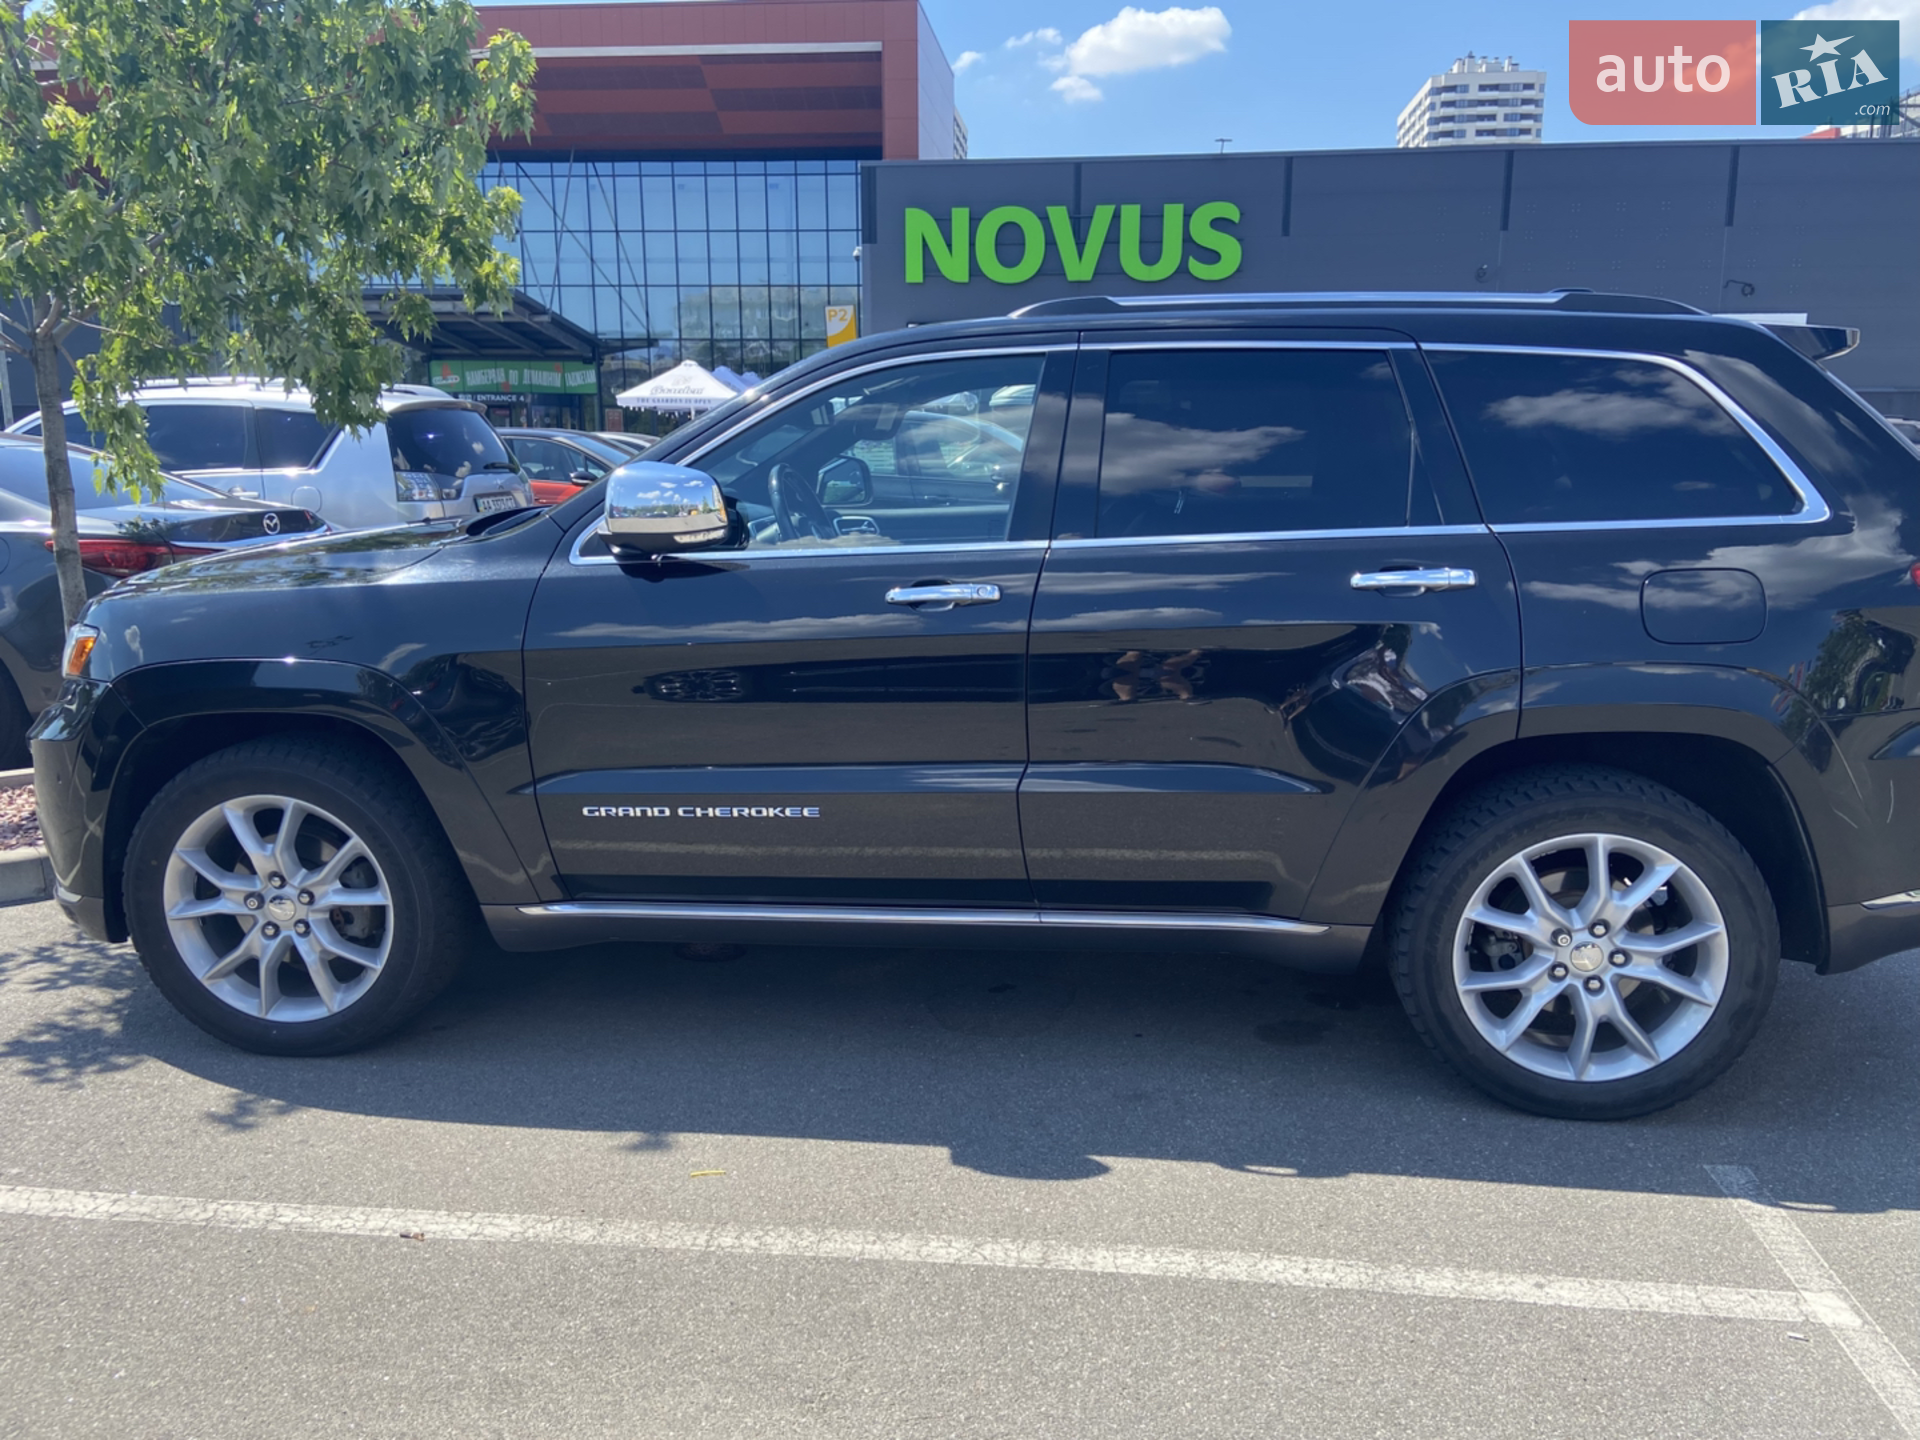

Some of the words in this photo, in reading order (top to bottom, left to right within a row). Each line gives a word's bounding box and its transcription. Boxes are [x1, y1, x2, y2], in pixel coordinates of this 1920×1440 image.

[905, 201, 1242, 284] NOVUS
[827, 309, 848, 323] P2
[477, 394, 517, 402] ENTRANCE
[582, 806, 671, 817] GRAND
[677, 806, 820, 818] CHEROKEE
